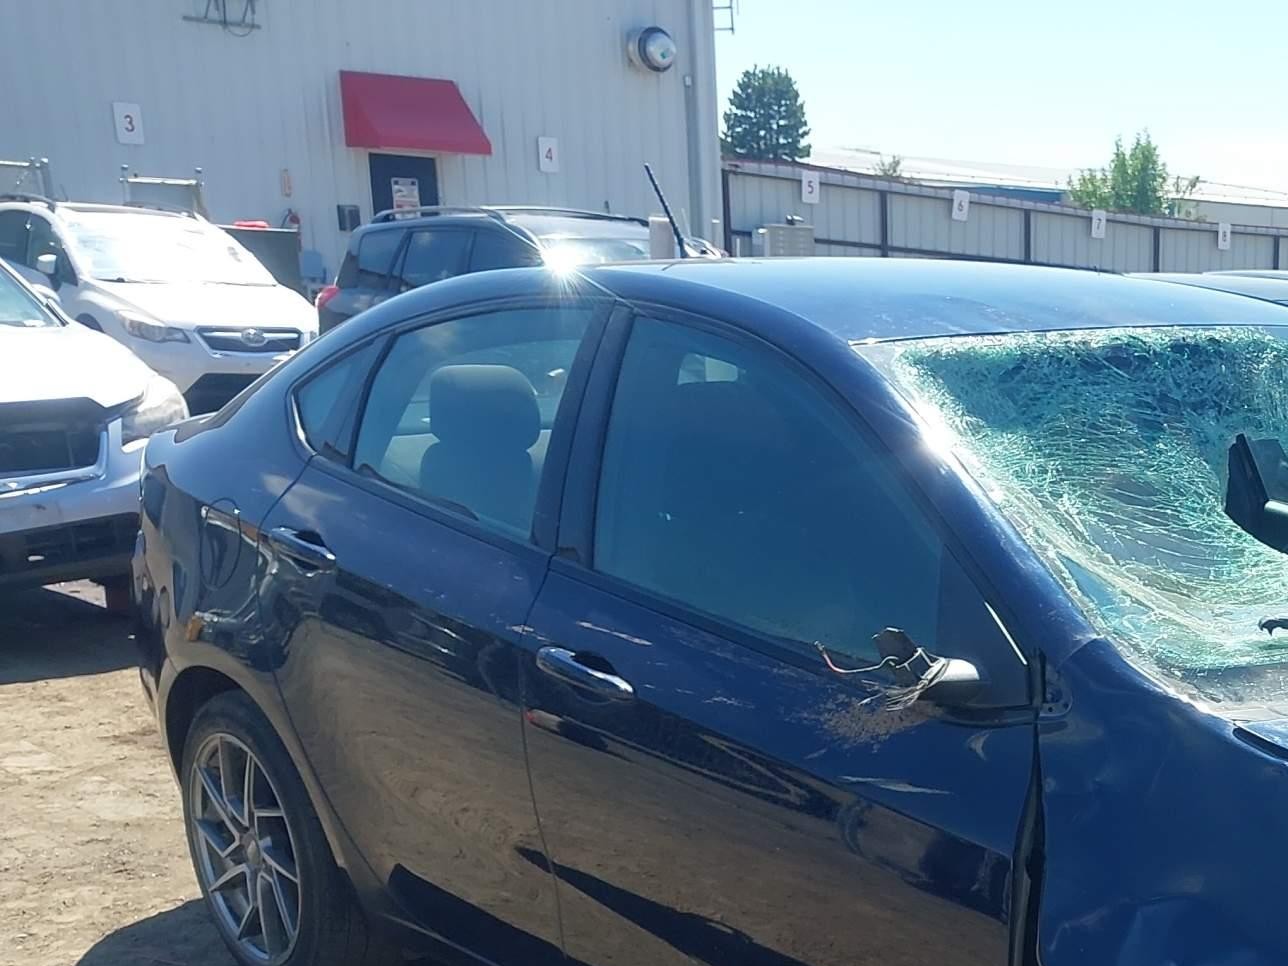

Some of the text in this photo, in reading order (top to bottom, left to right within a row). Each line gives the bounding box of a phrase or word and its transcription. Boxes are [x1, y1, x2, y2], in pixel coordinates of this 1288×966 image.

[123, 114, 135, 133] 3
[544, 147, 554, 163] 4
[807, 180, 815, 195] 5
[957, 200, 965, 212] 6
[1096, 217, 1102, 230] 7
